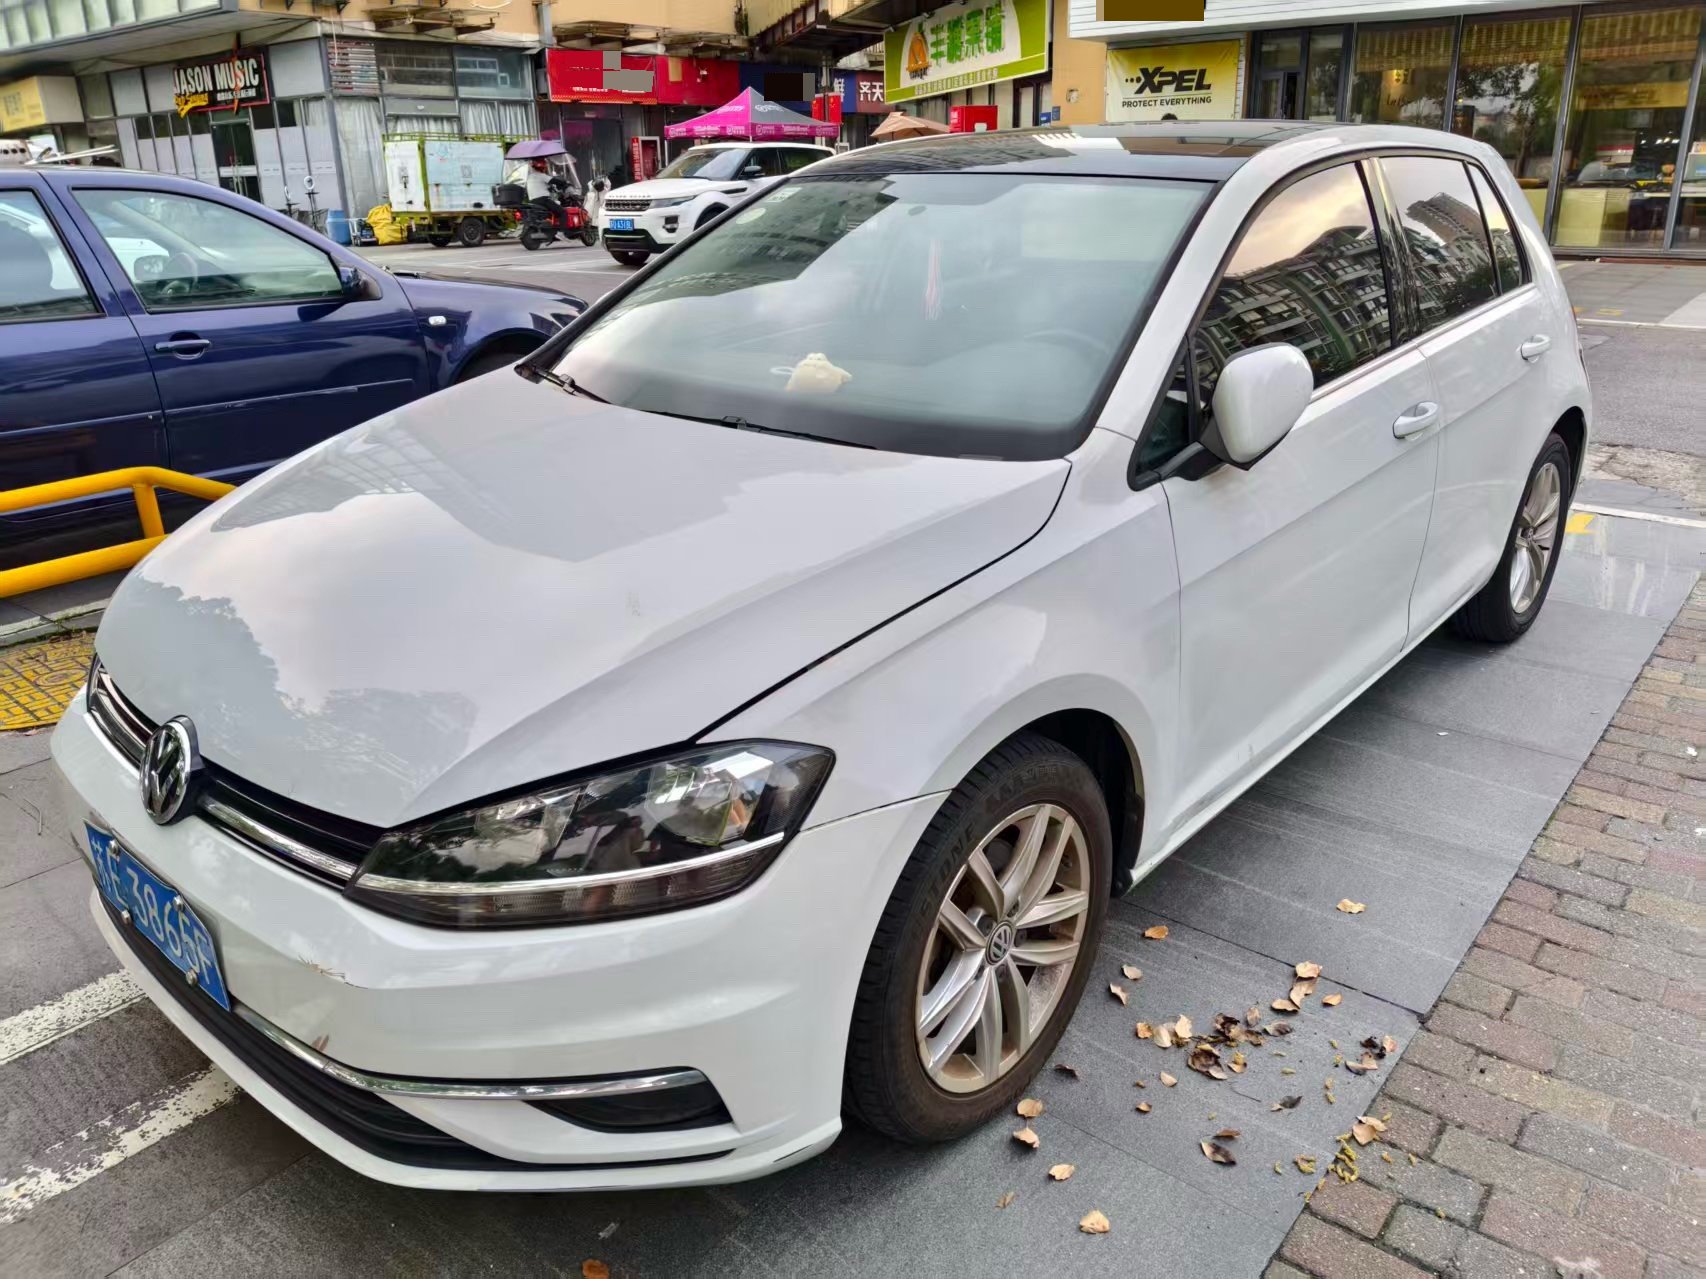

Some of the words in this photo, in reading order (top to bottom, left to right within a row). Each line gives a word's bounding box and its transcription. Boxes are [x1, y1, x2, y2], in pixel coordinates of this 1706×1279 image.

[173, 65, 213, 95] JASON
[214, 58, 259, 90] MUSIC
[1134, 66, 1212, 95] XPEL
[1122, 99, 1158, 108] PROTECT
[1159, 96, 1212, 106] EVERYTHING
